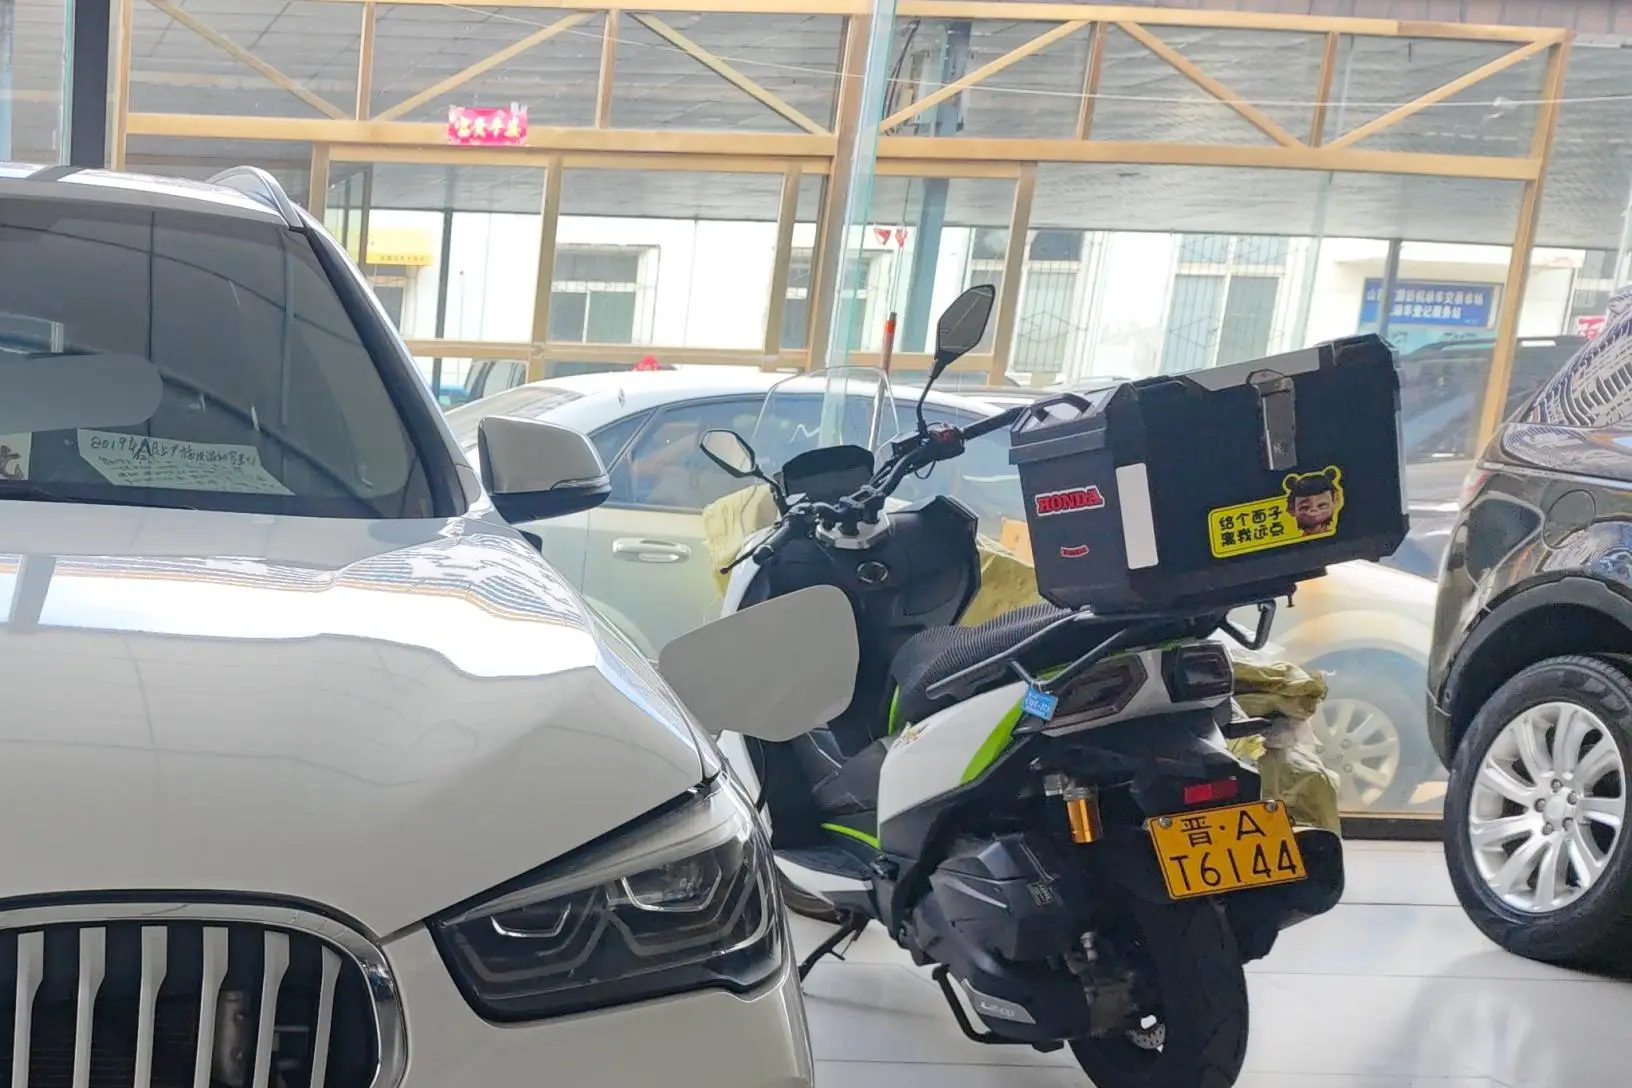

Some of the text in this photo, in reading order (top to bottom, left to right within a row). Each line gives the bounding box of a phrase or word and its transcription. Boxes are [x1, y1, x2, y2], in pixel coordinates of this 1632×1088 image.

[1037, 487, 1103, 514] HONDA
[1219, 505, 1282, 531] 给个面子
[1221, 522, 1285, 548] 离我远点
[1169, 839, 1297, 891] T6144
